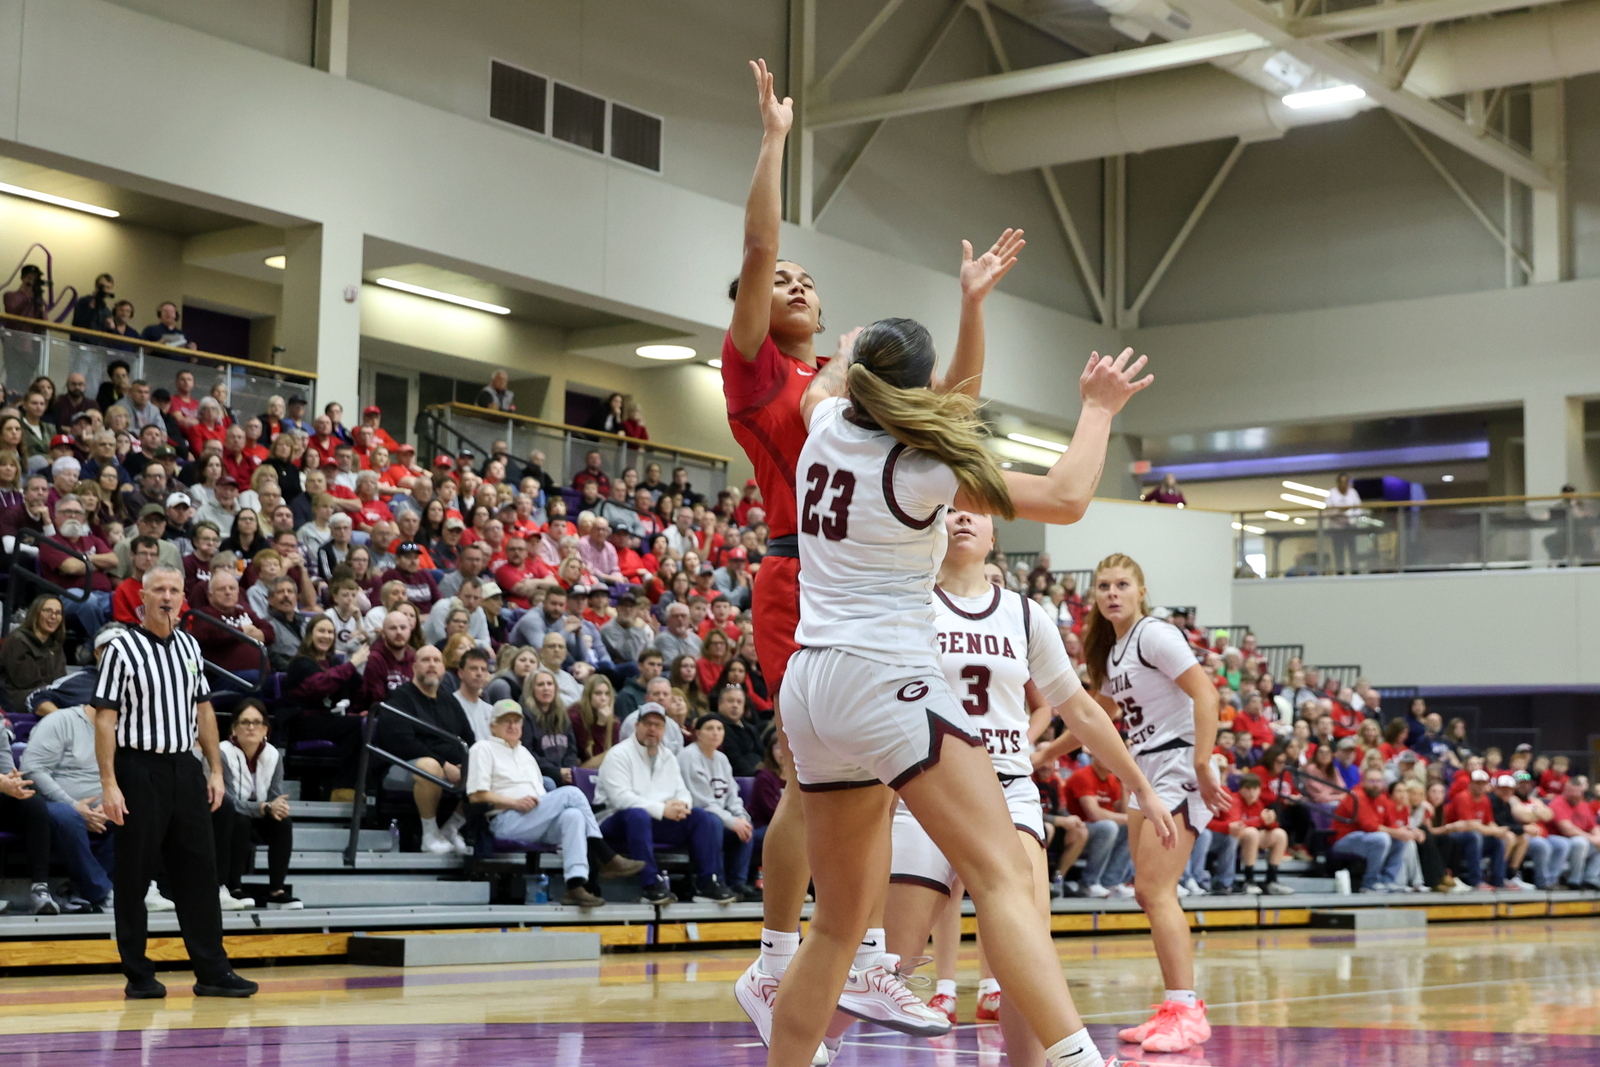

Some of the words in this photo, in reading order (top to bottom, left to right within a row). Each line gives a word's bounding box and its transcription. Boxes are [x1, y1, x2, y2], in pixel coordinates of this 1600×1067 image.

[801, 463, 856, 541] 23
[896, 680, 930, 702] G
[961, 663, 992, 717] 3
[977, 728, 1021, 754] ETS
